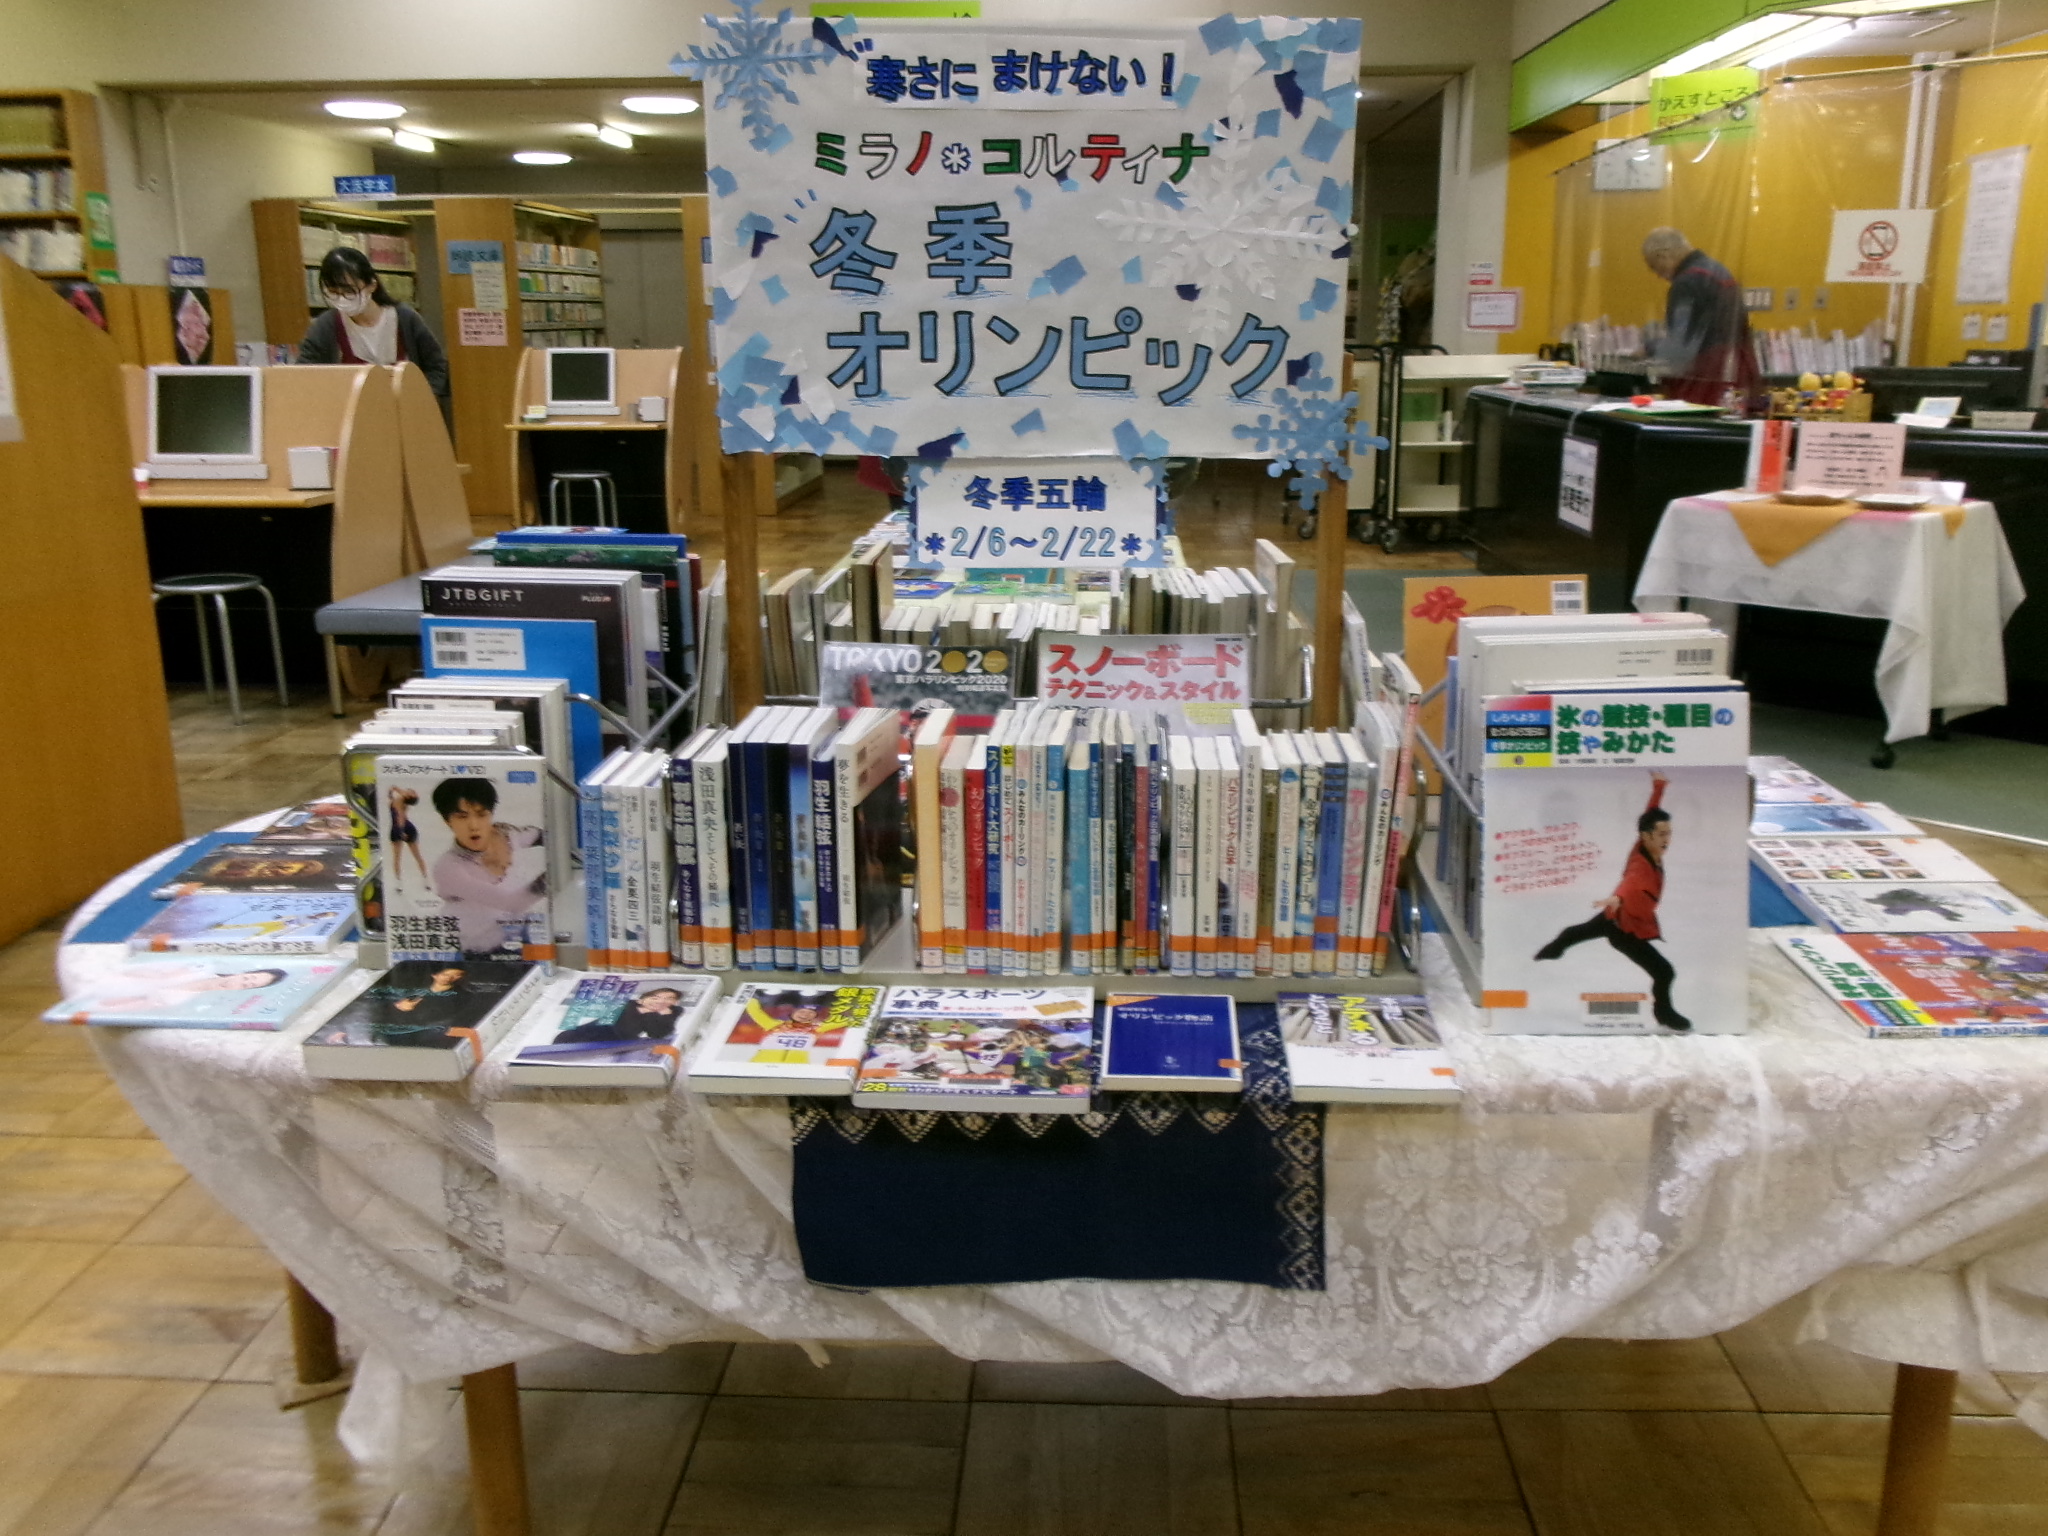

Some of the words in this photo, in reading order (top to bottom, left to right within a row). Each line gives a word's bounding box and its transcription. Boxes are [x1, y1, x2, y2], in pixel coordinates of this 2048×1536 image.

[867, 53, 979, 101] 寒さに
[991, 50, 1175, 98] まけない！
[809, 202, 1013, 296] 冬季
[826, 306, 1290, 406] オリンピック
[963, 475, 1108, 513] 冬季五輪
[441, 587, 525, 603] JTBGIFT
[1046, 643, 1243, 679] スノーボード
[389, 915, 461, 932] 羽生結弦
[389, 933, 462, 951] 浅田真央
[894, 988, 1047, 1000] パラスポーツ
